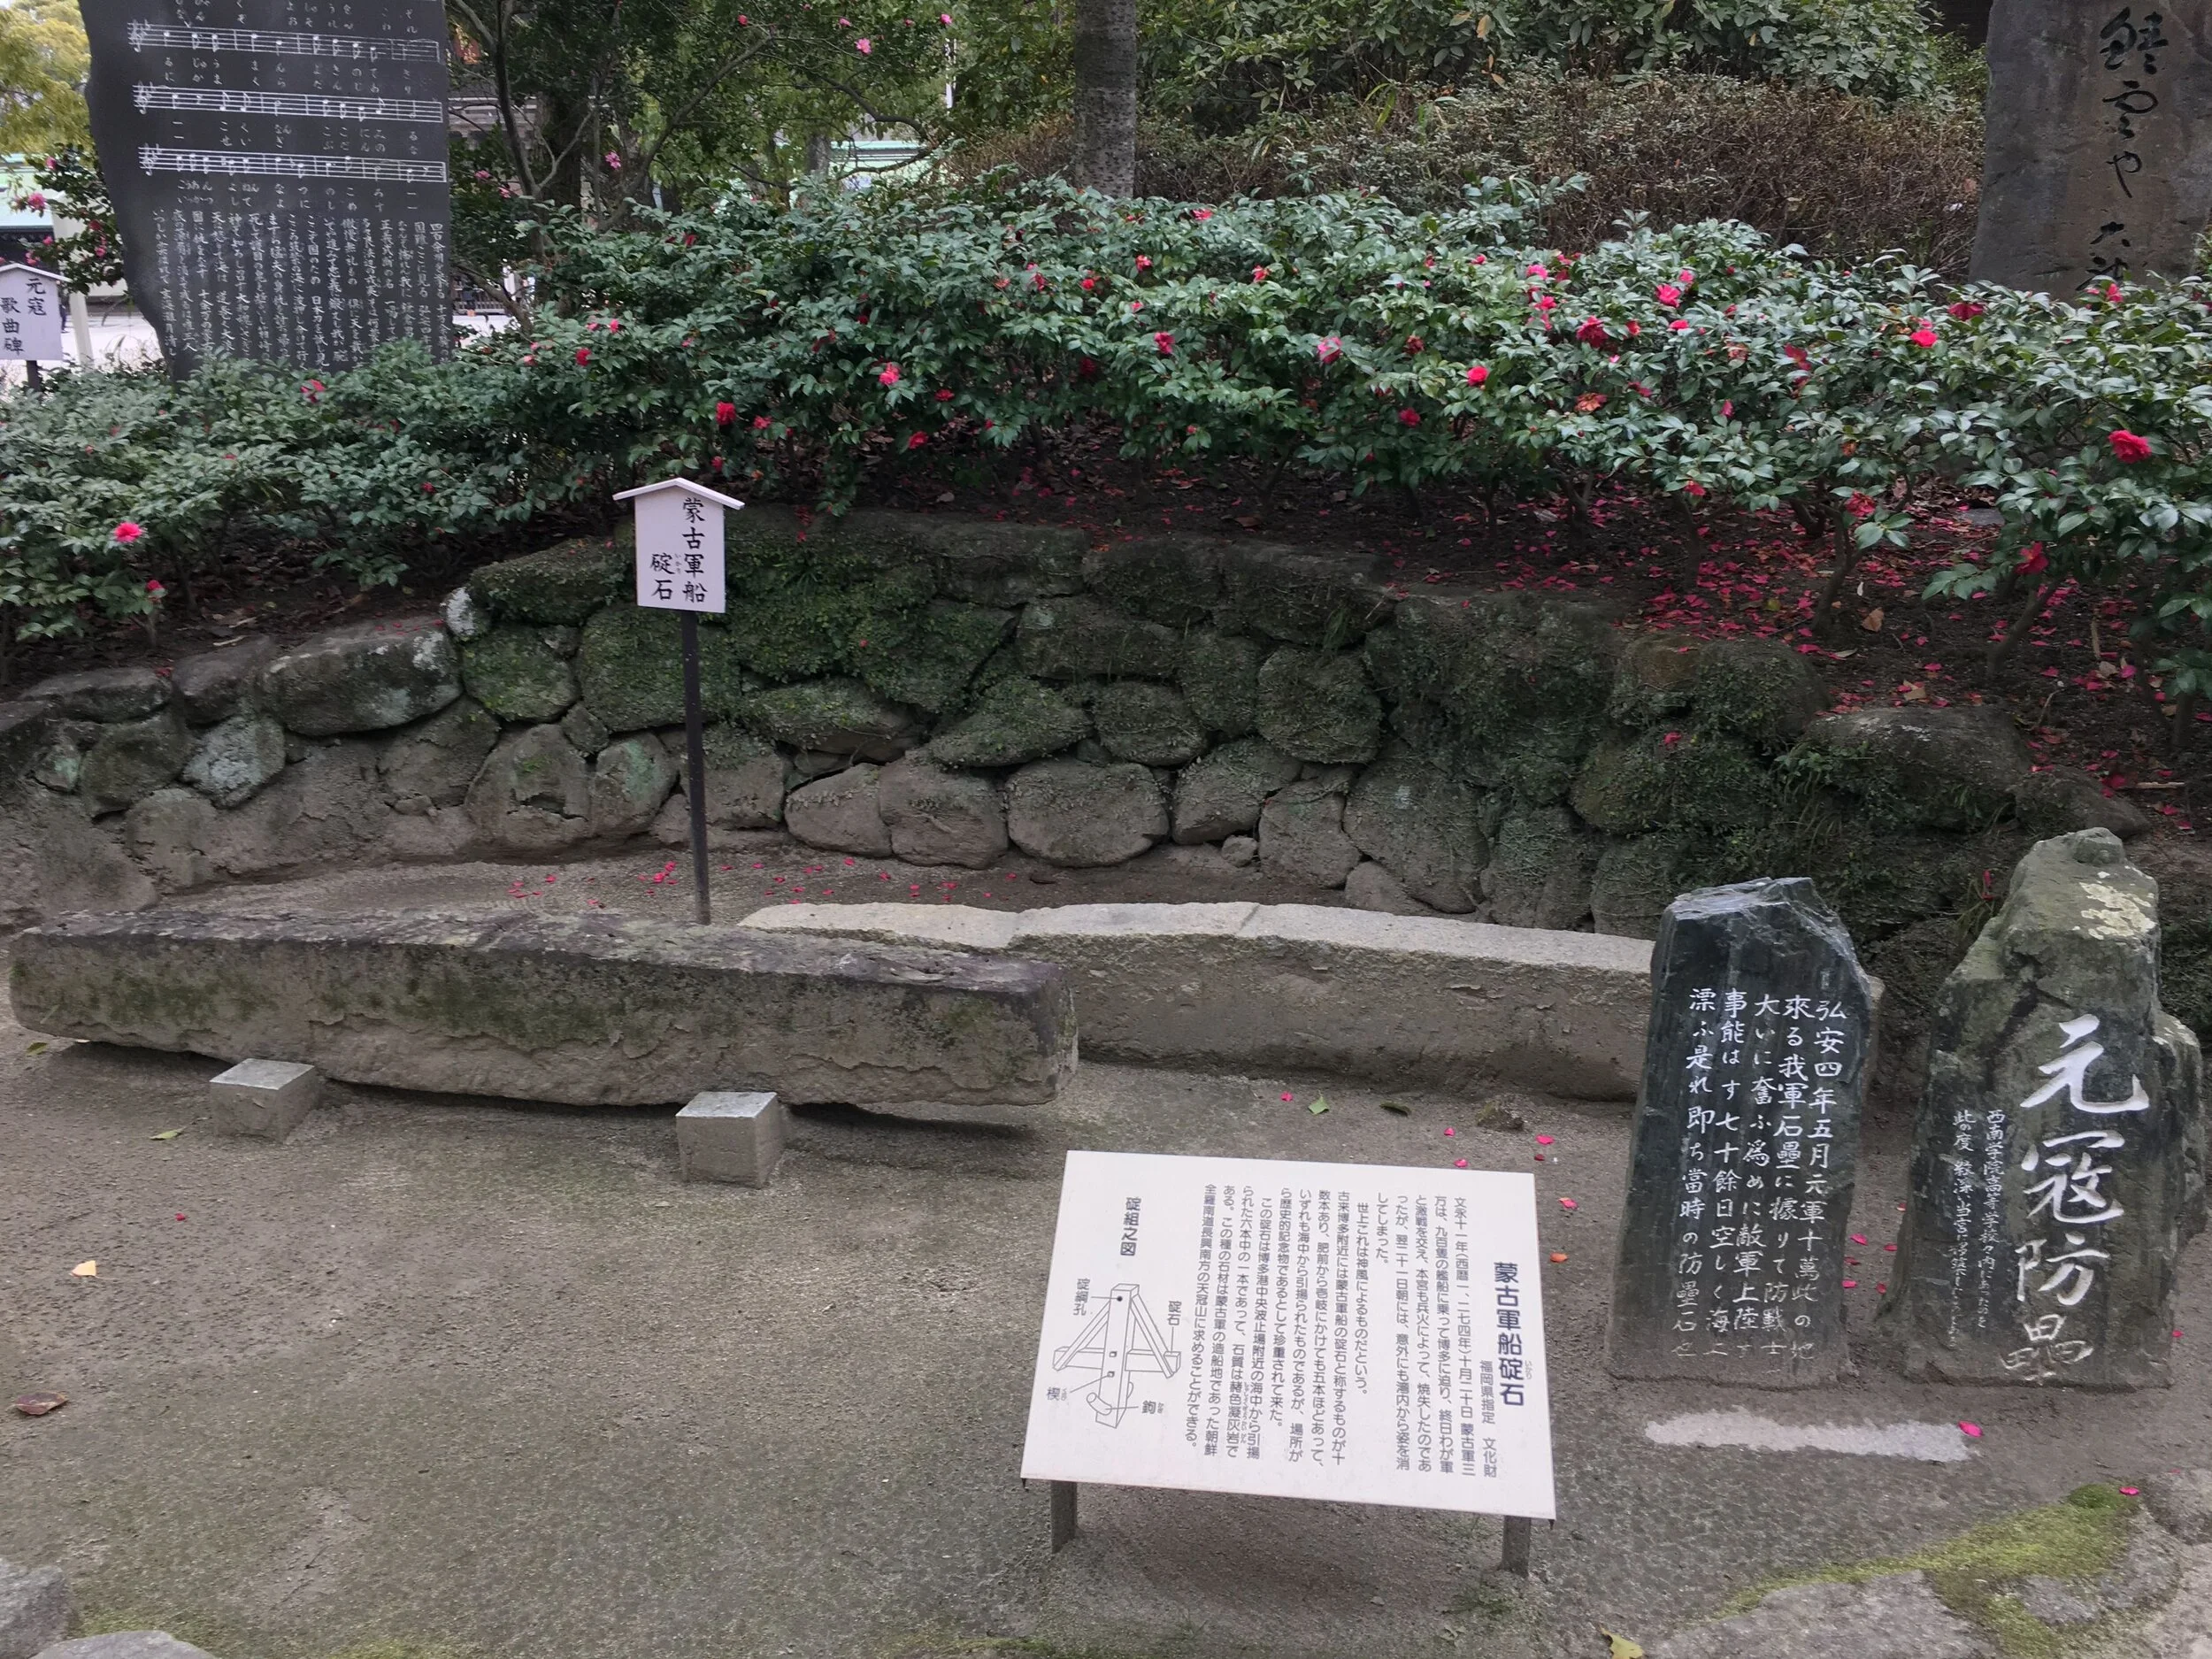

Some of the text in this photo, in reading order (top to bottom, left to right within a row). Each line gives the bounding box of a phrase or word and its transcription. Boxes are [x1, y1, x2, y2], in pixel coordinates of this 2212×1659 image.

[0, 296, 25, 357] 歌曲碑
[26, 278, 48, 317] 元寇
[649, 552, 676, 601] 碇石
[682, 496, 709, 603] 蒙古軍船
[1120, 1196, 1142, 1256] 碇組之図
[1375, 1192, 1390, 1264] してしまった。
[1167, 1300, 1183, 1326] 碇石
[1494, 1261, 1525, 1407] 蒙古軍船碇石
[1479, 1359, 1498, 1479] 福岡県指定 文化財
